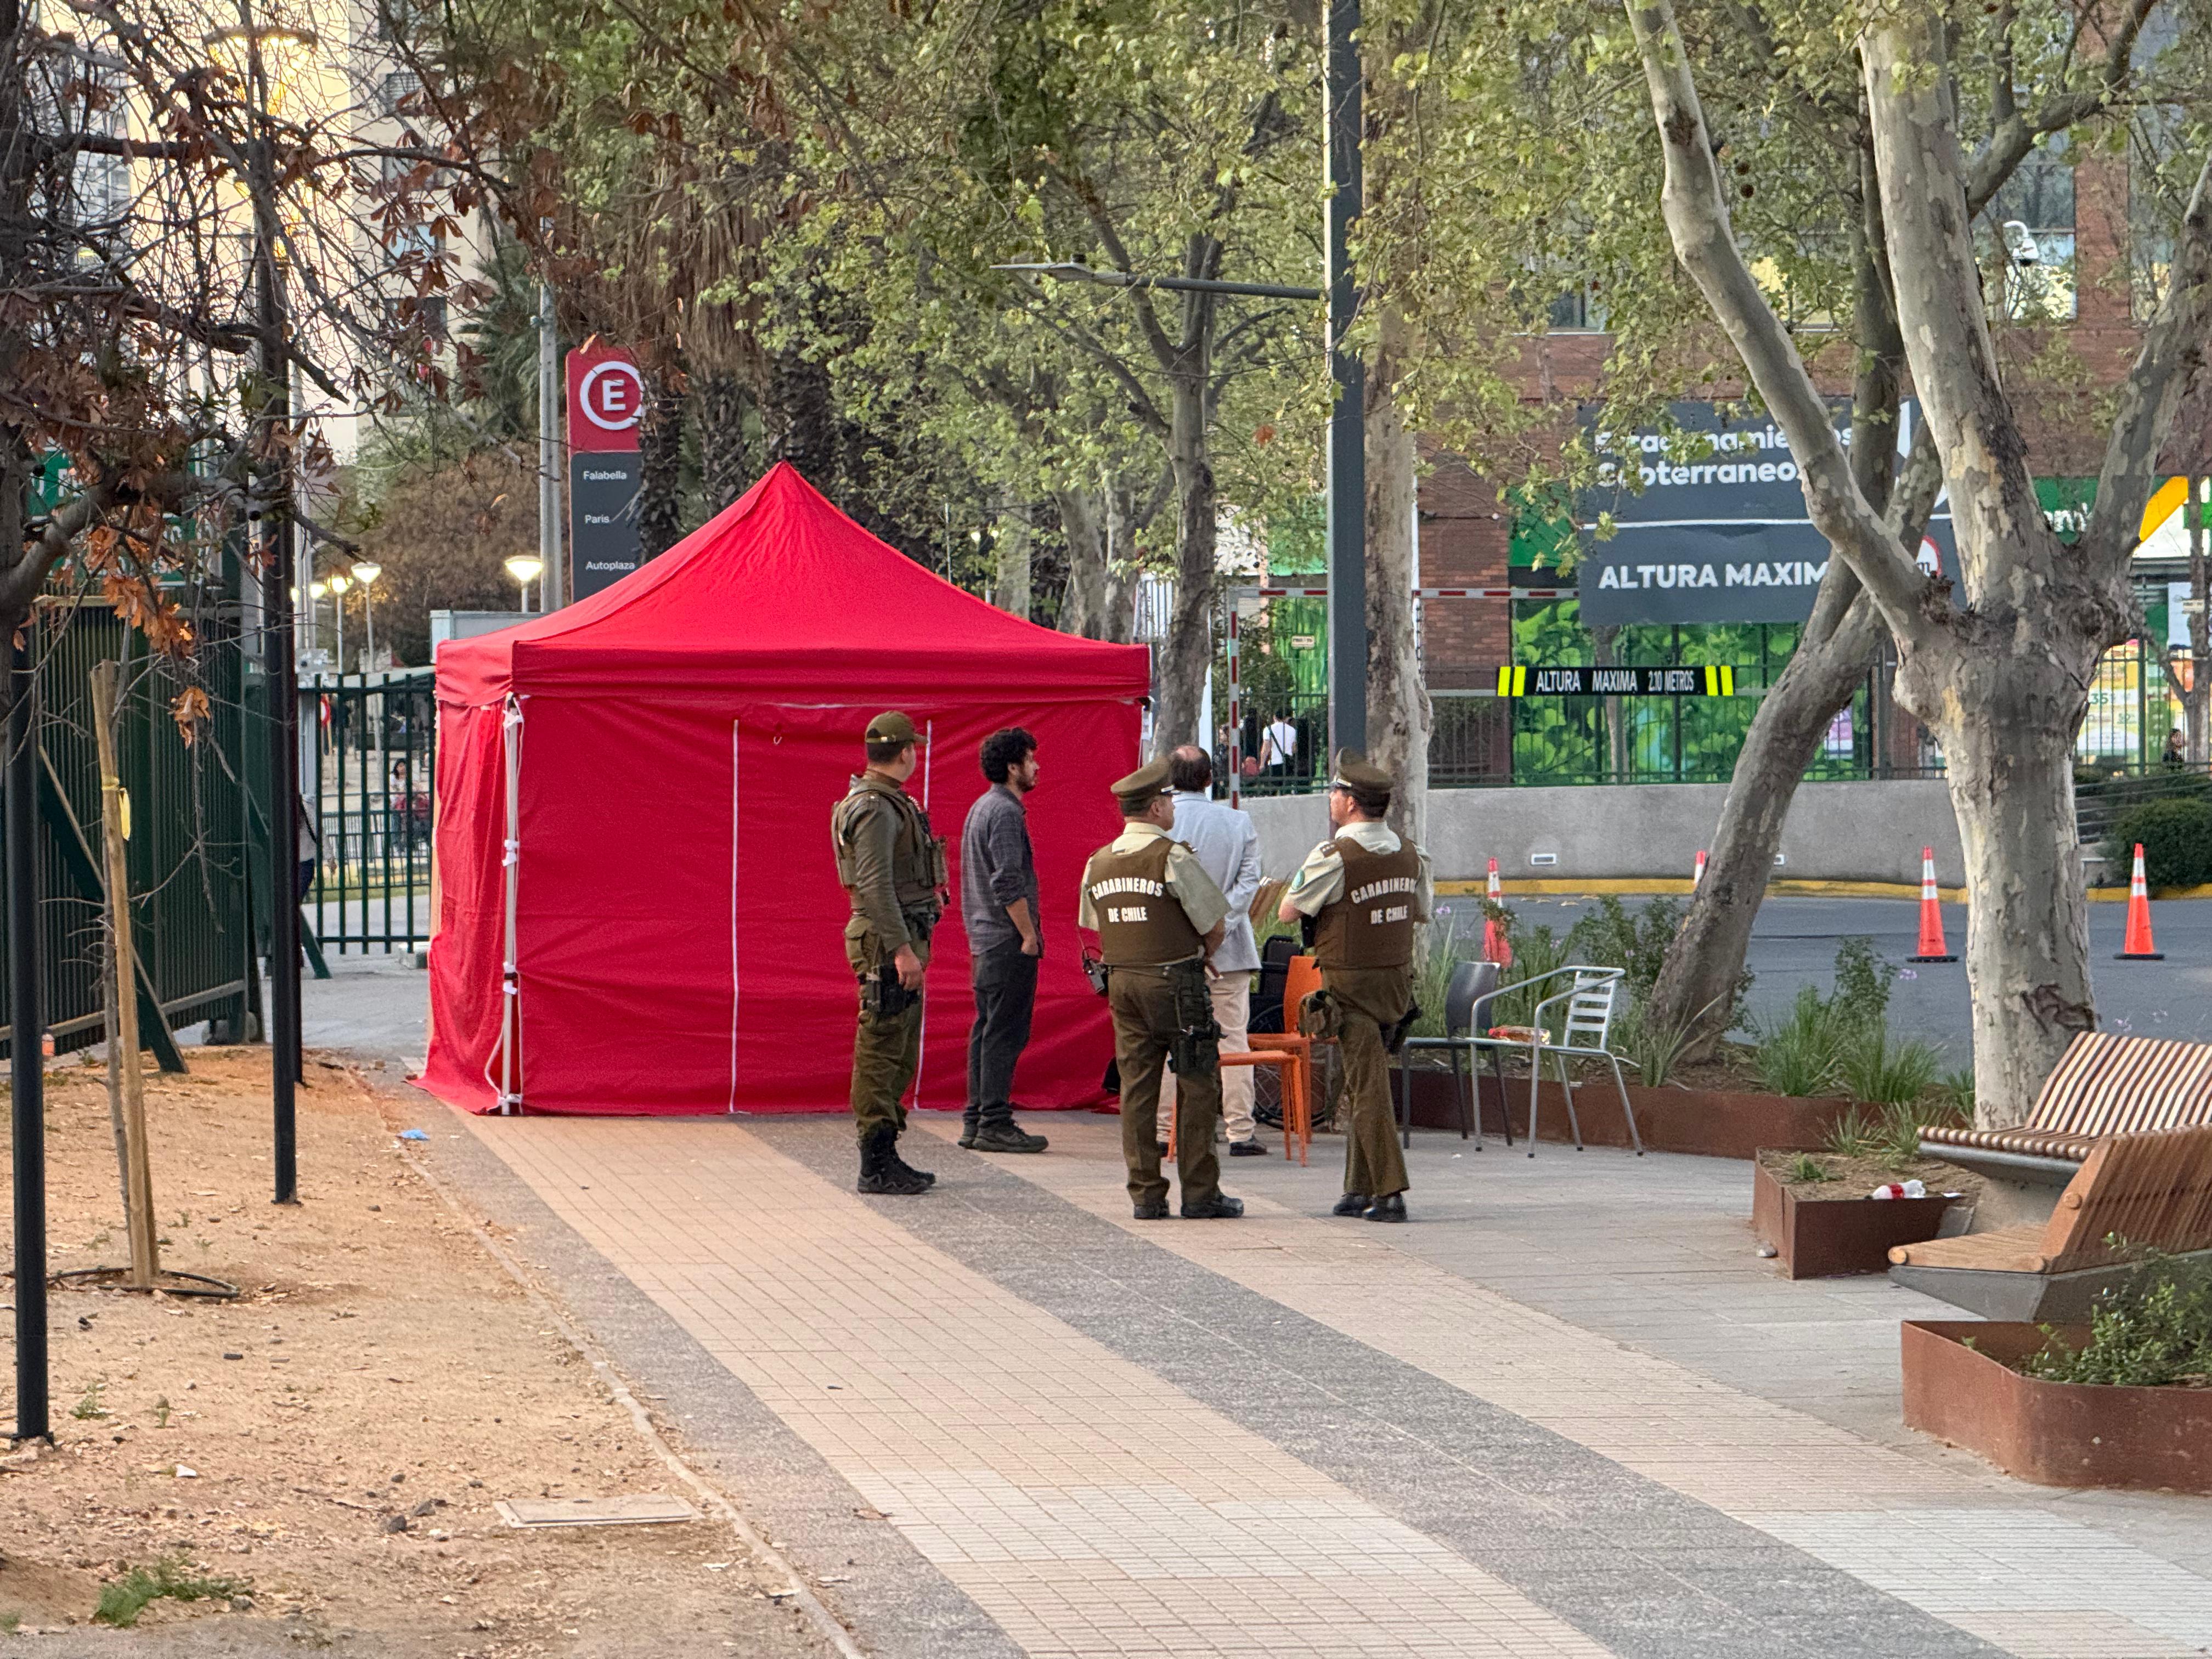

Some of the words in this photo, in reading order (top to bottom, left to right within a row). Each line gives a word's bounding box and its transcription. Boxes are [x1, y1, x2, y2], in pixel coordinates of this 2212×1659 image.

[602, 379, 626, 411] E
[583, 470, 627, 481] Falabella
[585, 515, 610, 524] Paris
[585, 561, 635, 572] Autoplaza
[1598, 565, 1718, 589] ALTURA
[1725, 561, 1829, 587] MAXIM
[1536, 670, 1581, 692] ALTURA
[1592, 670, 1638, 692] MAXIMA
[1664, 670, 1694, 692] METROS
[1092, 877, 1163, 900] CARABINEROS
[1108, 908, 1119, 923] DE
[1121, 906, 1147, 922] CHILE
[1371, 909, 1384, 924] DE
[1386, 905, 1408, 922] CHILE
